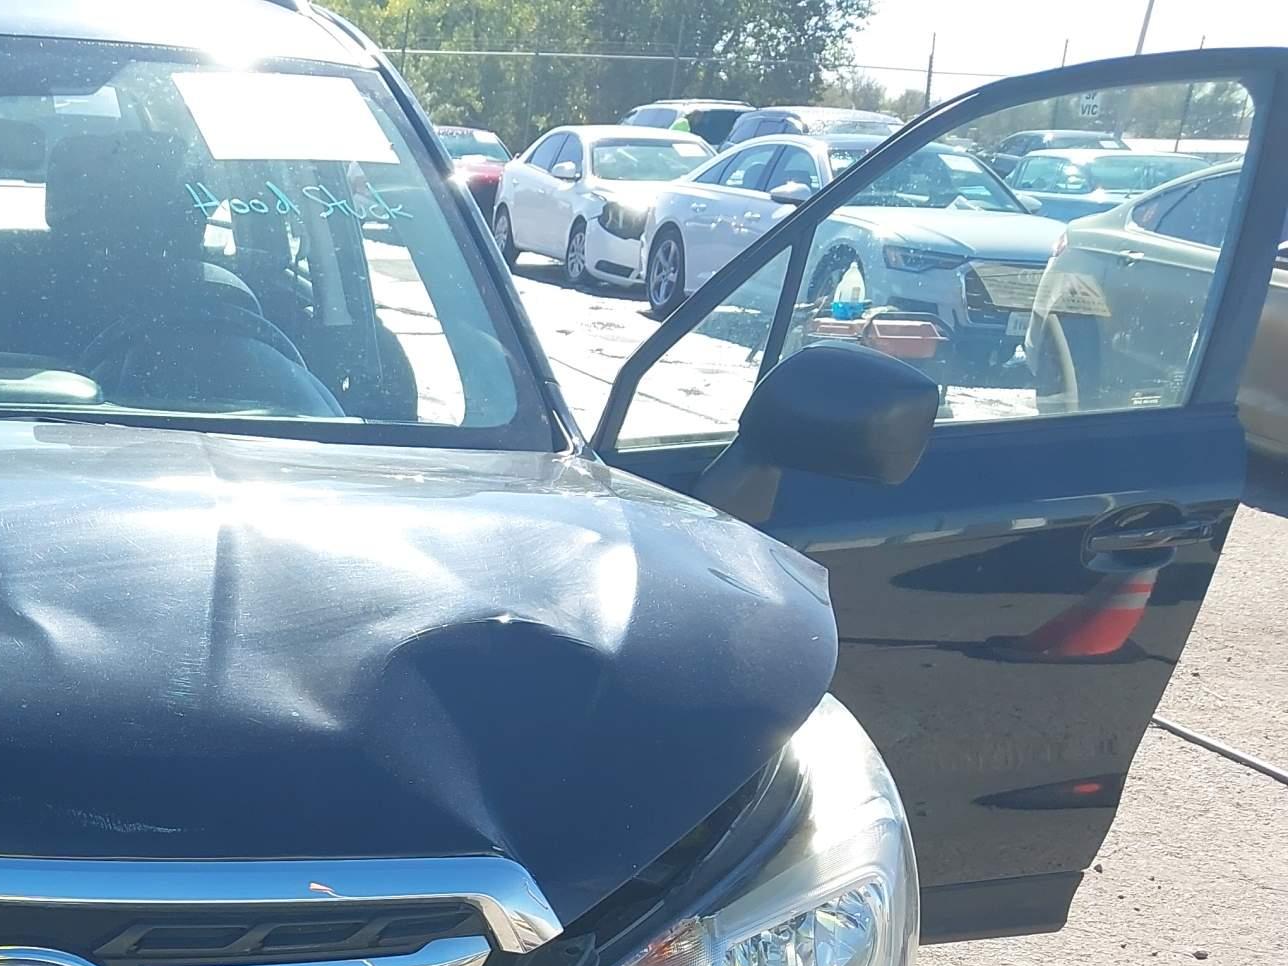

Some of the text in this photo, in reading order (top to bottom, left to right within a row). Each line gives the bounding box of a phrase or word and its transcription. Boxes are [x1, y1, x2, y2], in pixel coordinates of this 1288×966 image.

[1081, 104, 1098, 115] VIC
[184, 181, 414, 220] Hood Stuck
